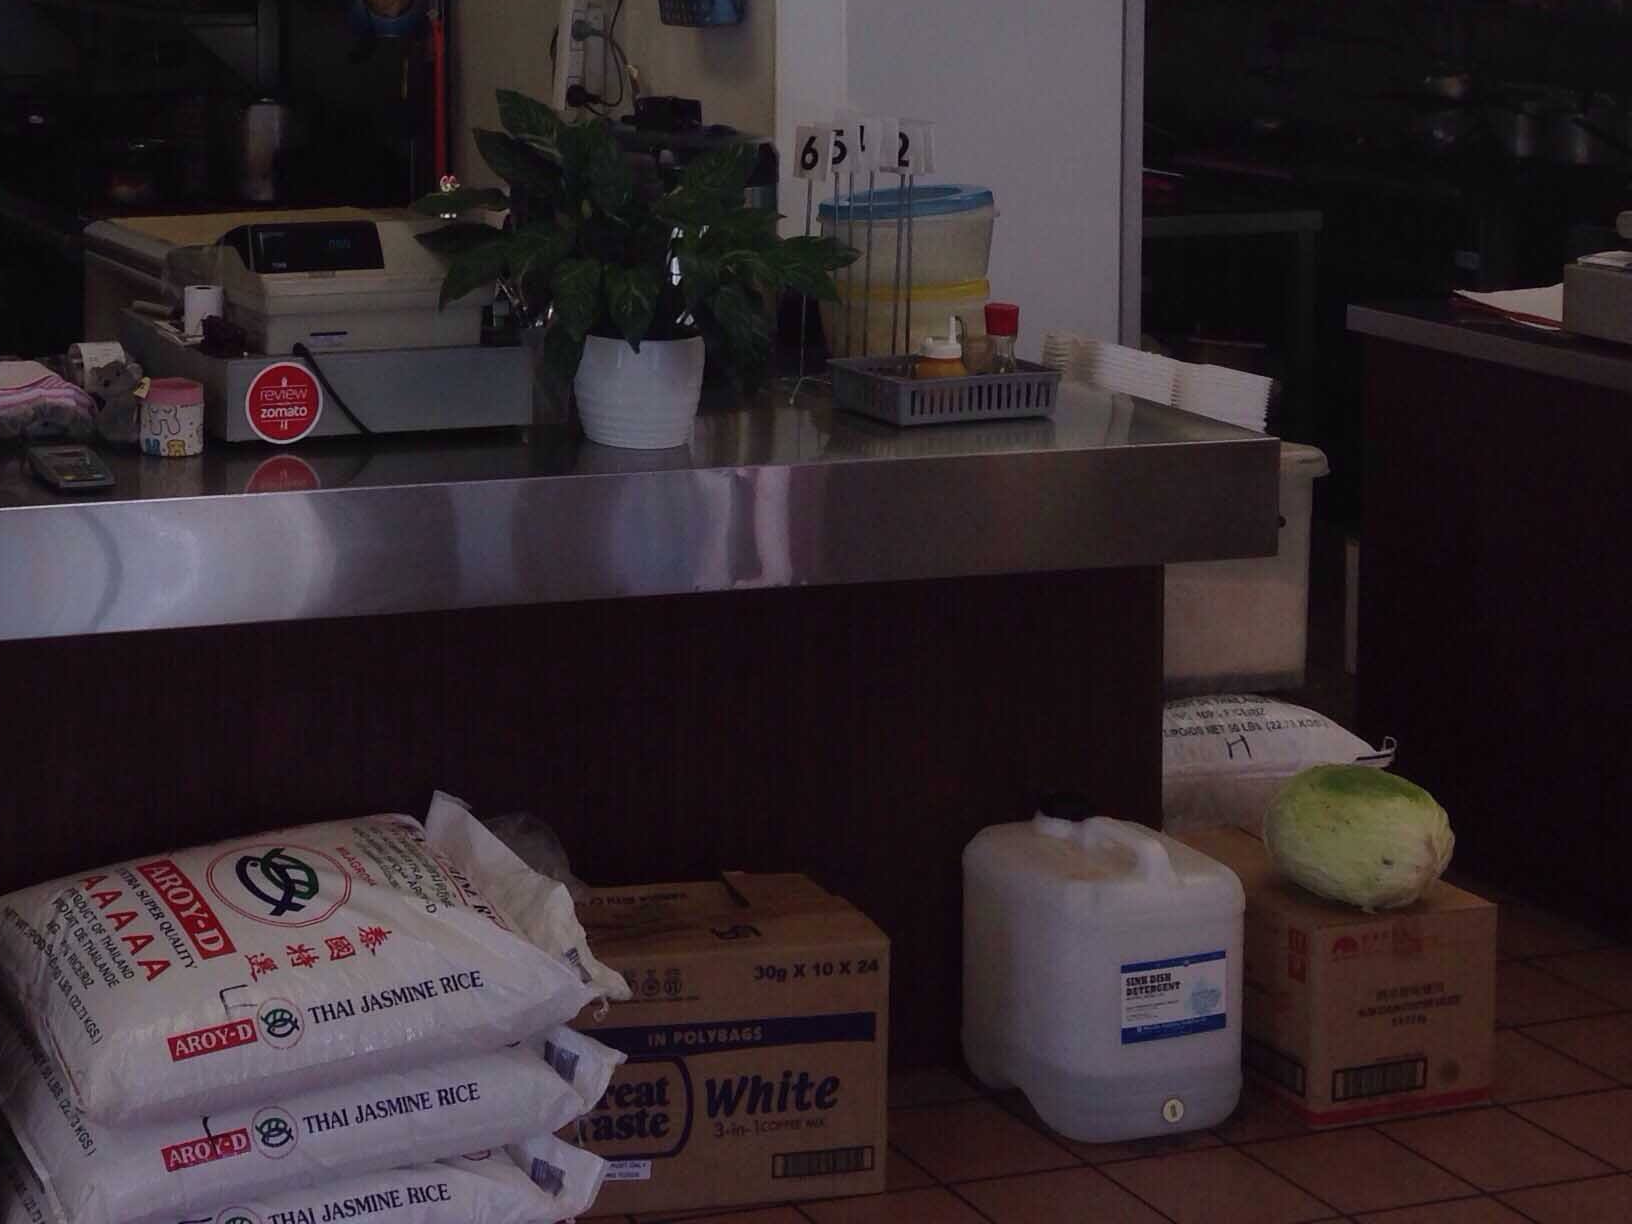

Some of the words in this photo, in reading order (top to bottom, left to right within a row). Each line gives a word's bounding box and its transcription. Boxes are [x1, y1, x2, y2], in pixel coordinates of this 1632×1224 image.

[800, 136, 818, 170] 6
[259, 387, 309, 401] review
[260, 406, 308, 419] zomato
[149, 864, 226, 953] AROY-D
[136, 889, 165, 921] SUPER
[160, 920, 198, 969] QUALITY
[101, 932, 134, 980] THAILAND
[753, 965, 787, 982] 30g
[793, 963, 809, 978] X
[814, 962, 833, 977] 10
[839, 960, 853, 976] X
[858, 959, 880, 975] 24
[1126, 981, 1181, 997] DETERGENT
[174, 1022, 254, 1057] AROY-D
[308, 998, 356, 1025] THAI
[360, 980, 438, 1013] JASMINE
[440, 970, 484, 992] RICE
[648, 1032, 666, 1046] IN
[673, 1027, 764, 1044] POLYBAGS
[596, 1077, 670, 1109] reat
[705, 1070, 840, 1119] White
[167, 1131, 249, 1167] AROY-D
[302, 1109, 351, 1135] THAI
[354, 1090, 433, 1124] JASMINE
[437, 1083, 481, 1106] RICE
[322, 1190, 404, 1224] JASMINE
[406, 1183, 452, 1204] RICE
